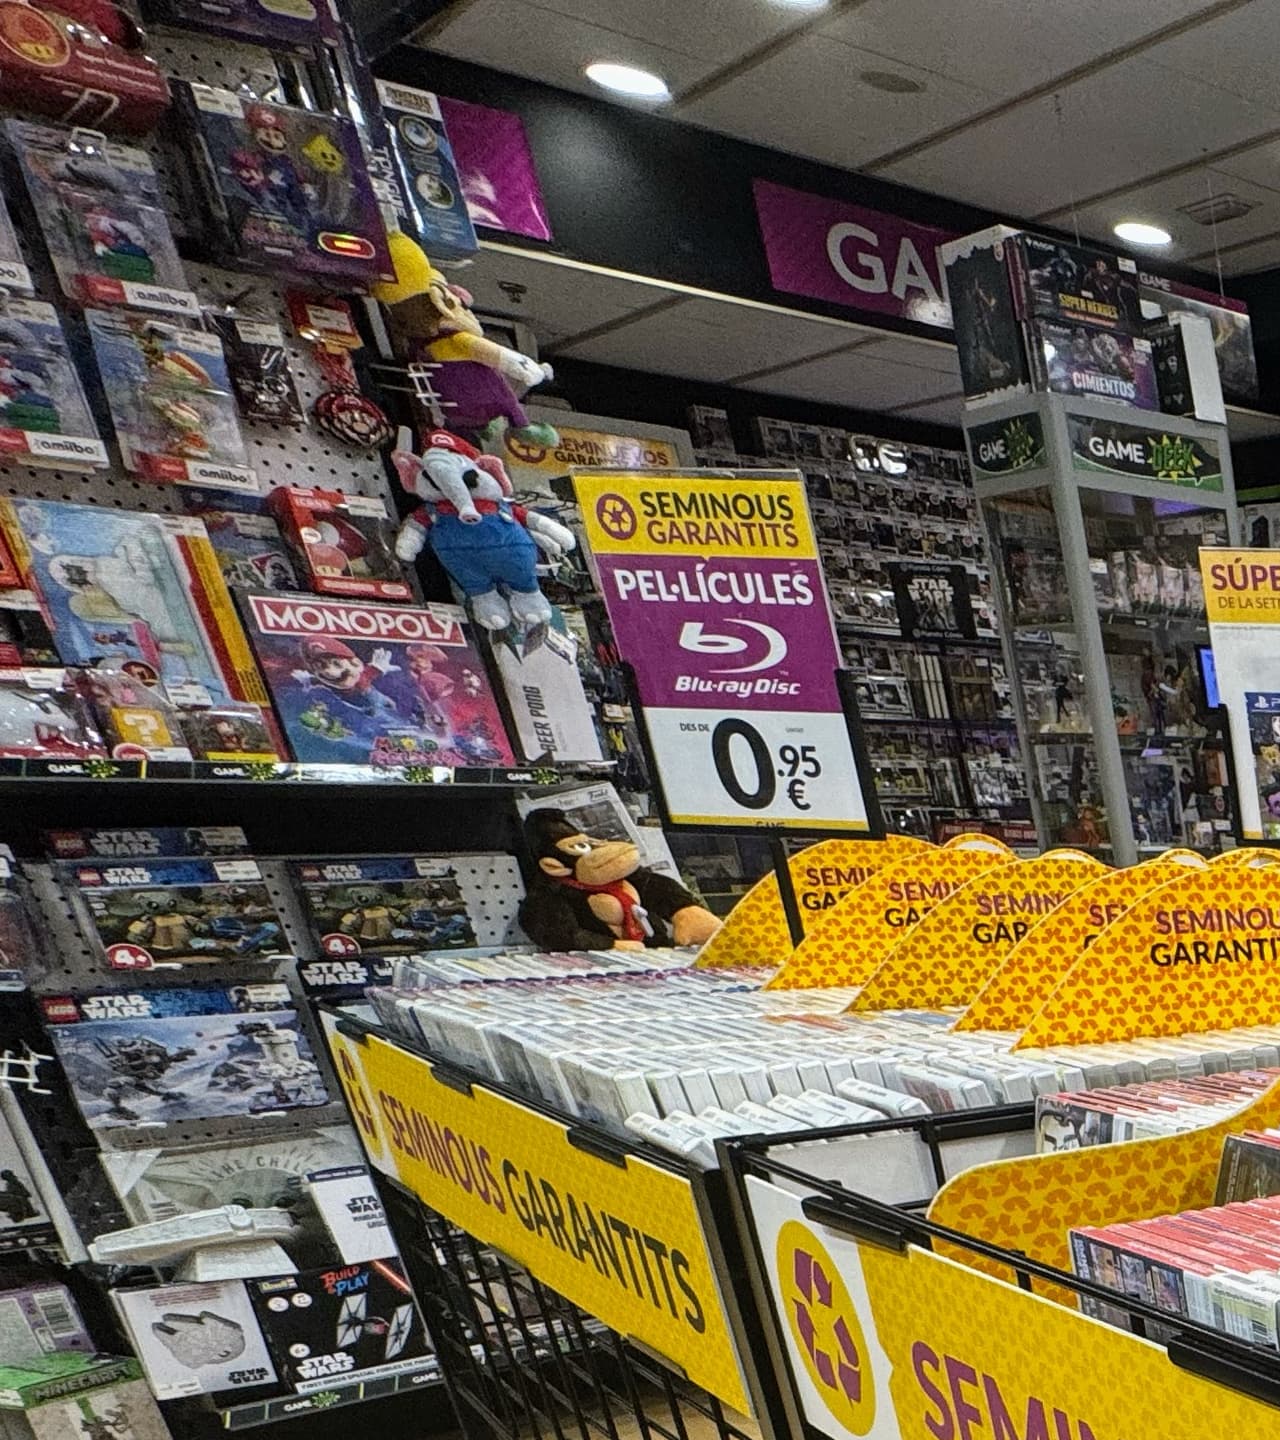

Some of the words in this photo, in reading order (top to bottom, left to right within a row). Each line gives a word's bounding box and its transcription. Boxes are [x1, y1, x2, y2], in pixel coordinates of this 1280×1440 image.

[137, 289, 188, 308] amiibo
[1072, 371, 1136, 399] CIMIENTOS
[1089, 437, 1145, 464] GAME
[199, 467, 248, 484] amiibo
[640, 491, 794, 522] SEMINOUS
[646, 519, 799, 548] GARANTITS
[1219, 596, 1237, 609] DE
[1238, 596, 1254, 609] LA
[262, 602, 455, 642] MONOPOLY
[302, 971, 368, 985] WARS
[303, 962, 359, 976] STAR
[88, 995, 144, 1007] STAR
[82, 1005, 152, 1018] WARS
[378, 1090, 507, 1217] SEMINOUS
[500, 1159, 707, 1335] GARANTITS
